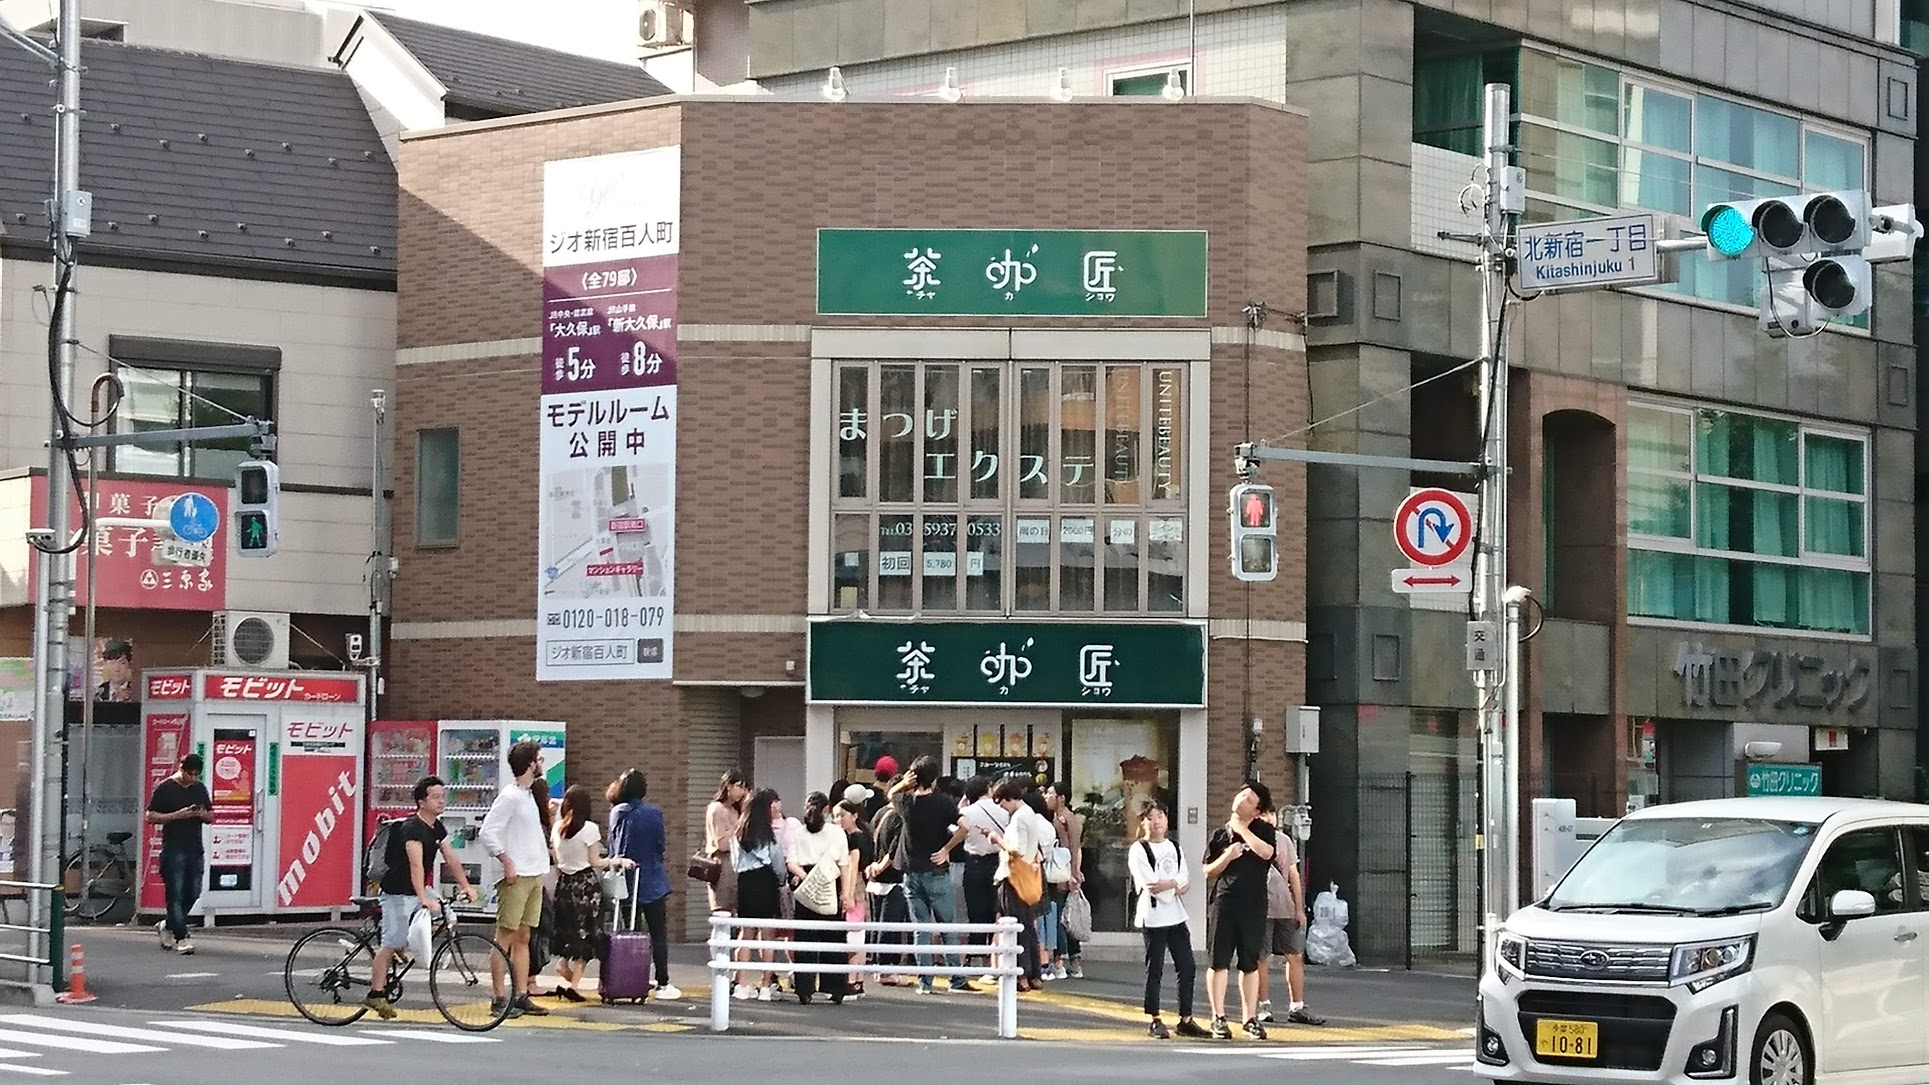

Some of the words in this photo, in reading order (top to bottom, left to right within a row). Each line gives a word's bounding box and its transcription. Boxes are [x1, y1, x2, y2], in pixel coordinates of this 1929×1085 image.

[550, 220, 674, 254] ジオ新宿百人町
[1524, 223, 1647, 263] 北新宿一丁目
[1536, 260, 1622, 280] Kitashinjuku
[1628, 257, 1636, 271] 1
[567, 346, 596, 381] 5分
[633, 340, 663, 376] 8分
[546, 397, 670, 428] モデルルーム
[840, 408, 957, 440] まつげ
[569, 427, 646, 458] 公開中
[1158, 371, 1172, 493] UNITEBEAUTY
[924, 451, 1094, 486] エクステ
[881, 556, 910, 570] 初回
[563, 606, 664, 629] 0120-018-079
[150, 678, 190, 695] モビット
[219, 677, 304, 699] モビット
[1673, 641, 1871, 713] 竹田クリニック
[303, 692, 342, 701] カードローン
[287, 721, 353, 739] モビット
[215, 743, 253, 755] モビット
[278, 769, 357, 907] mobit
[1552, 1035, 1591, 1054] 10-81
